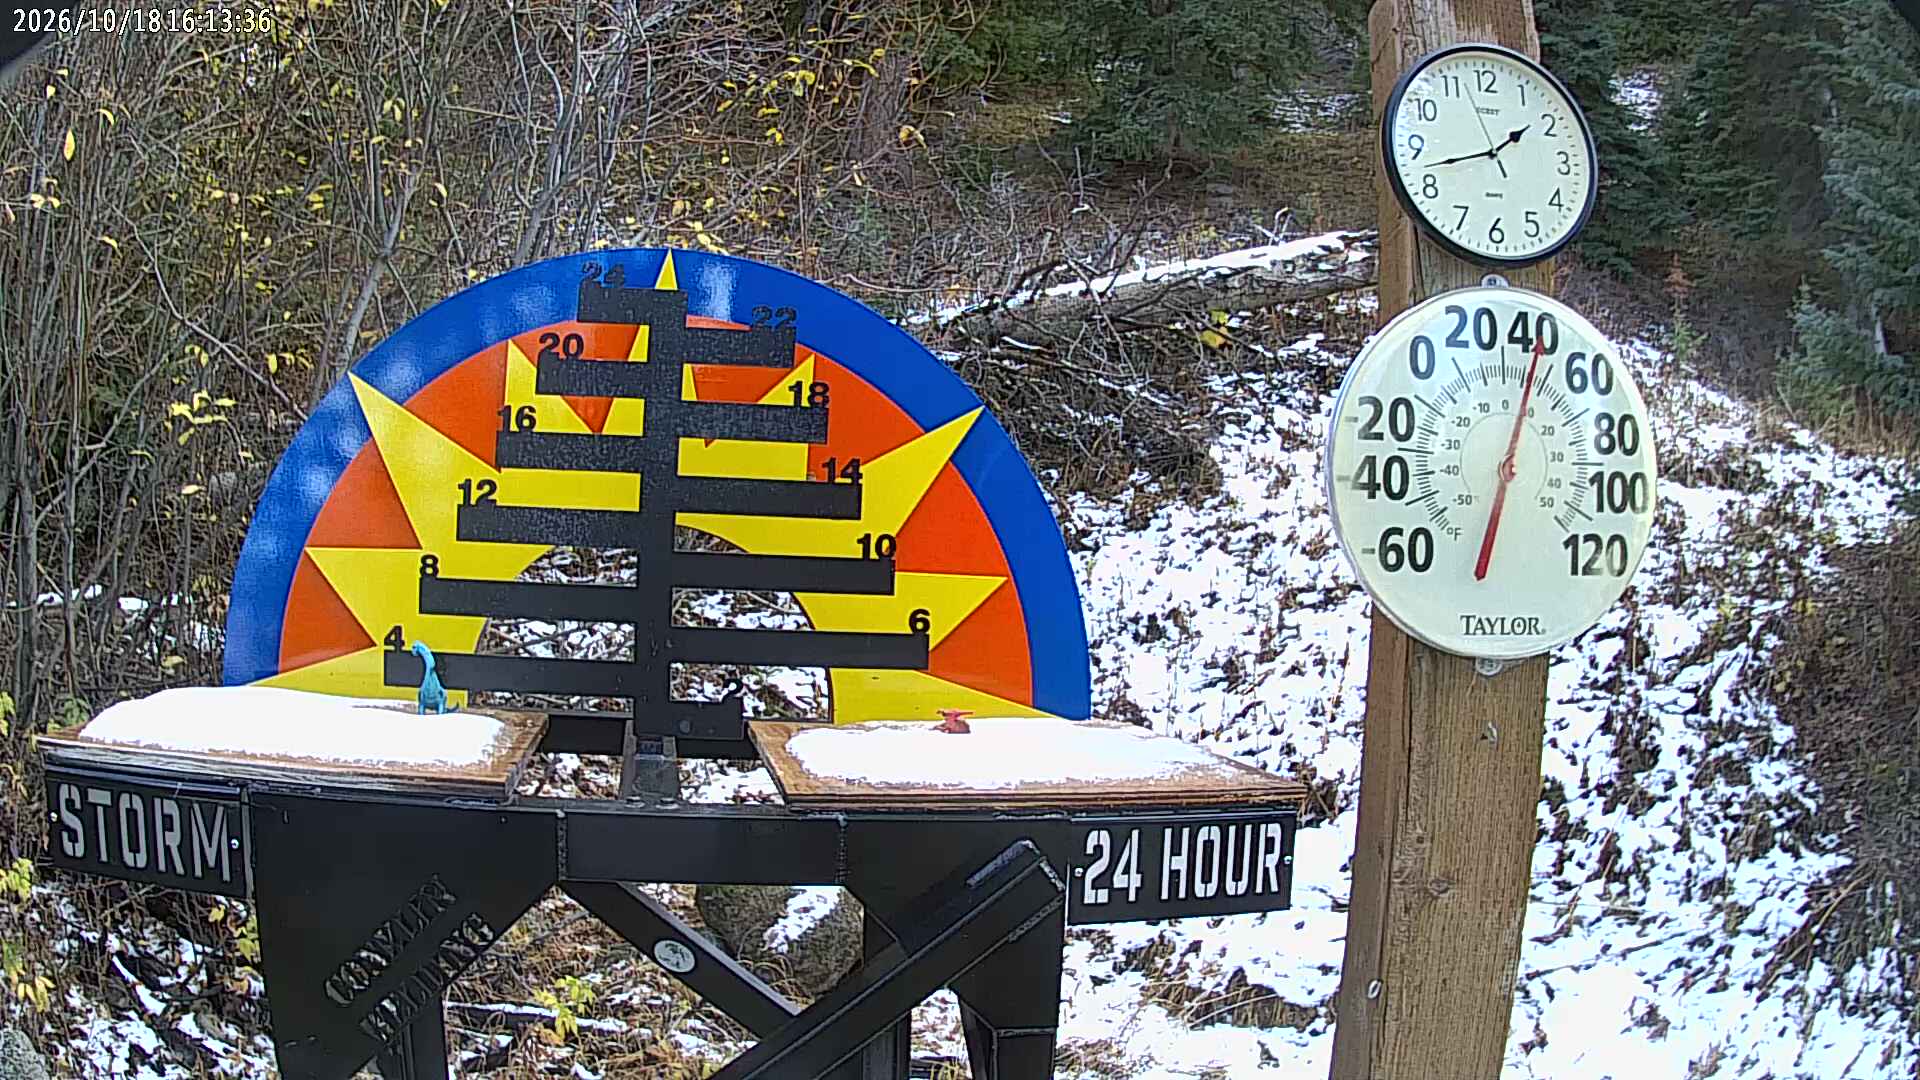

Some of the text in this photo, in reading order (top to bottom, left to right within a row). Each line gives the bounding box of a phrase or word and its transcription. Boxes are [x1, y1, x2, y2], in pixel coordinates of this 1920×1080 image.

[1441, 75, 1461, 99] 11
[1473, 69, 1499, 94] 12
[1517, 84, 1527, 107] 1
[1414, 98, 1438, 122] 10
[1541, 113, 1557, 138] 2
[1407, 134, 1425, 161] 9
[1556, 151, 1571, 176] 3
[1422, 173, 1439, 199] 8
[1548, 187, 1565, 213] 4
[1453, 205, 1470, 231] 7
[1488, 217, 1505, 244] 6
[1524, 211, 1540, 238] 5
[580, 262, 626, 288] 24
[752, 306, 798, 331] 22
[1445, 304, 1499, 351] 20
[538, 332, 585, 360] 20
[1507, 311, 1560, 356] 40
[1408, 334, 1437, 380] 0
[1564, 352, 1614, 396] 60
[788, 381, 830, 408] 18
[1501, 399, 1510, 411] 0
[497, 405, 537, 434] 16
[1344, 396, 1416, 443] -20
[1472, 402, 1490, 414] -10
[1451, 416, 1470, 428] -20
[1541, 425, 1555, 436] 20
[1593, 412, 1640, 457] 80
[1440, 439, 1460, 451] -30
[1550, 451, 1564, 463] 30
[821, 457, 863, 485] 14
[1336, 454, 1411, 501] -40
[1439, 464, 1460, 477] -40
[1547, 477, 1561, 489] 40
[456, 478, 498, 508] 12
[1452, 494, 1472, 506] -50
[1539, 496, 1554, 508] 50
[1587, 470, 1650, 514] 100
[856, 534, 897, 561] 10
[1361, 526, 1435, 573] -60
[1562, 533, 1630, 577] 120
[419, 554, 440, 580] 8
[908, 608, 931, 634] 6
[1459, 614, 1542, 636] TAYLOR
[383, 625, 406, 652] 4
[58, 782, 232, 883] STORM
[1082, 822, 1283, 904] 24 HOUR
